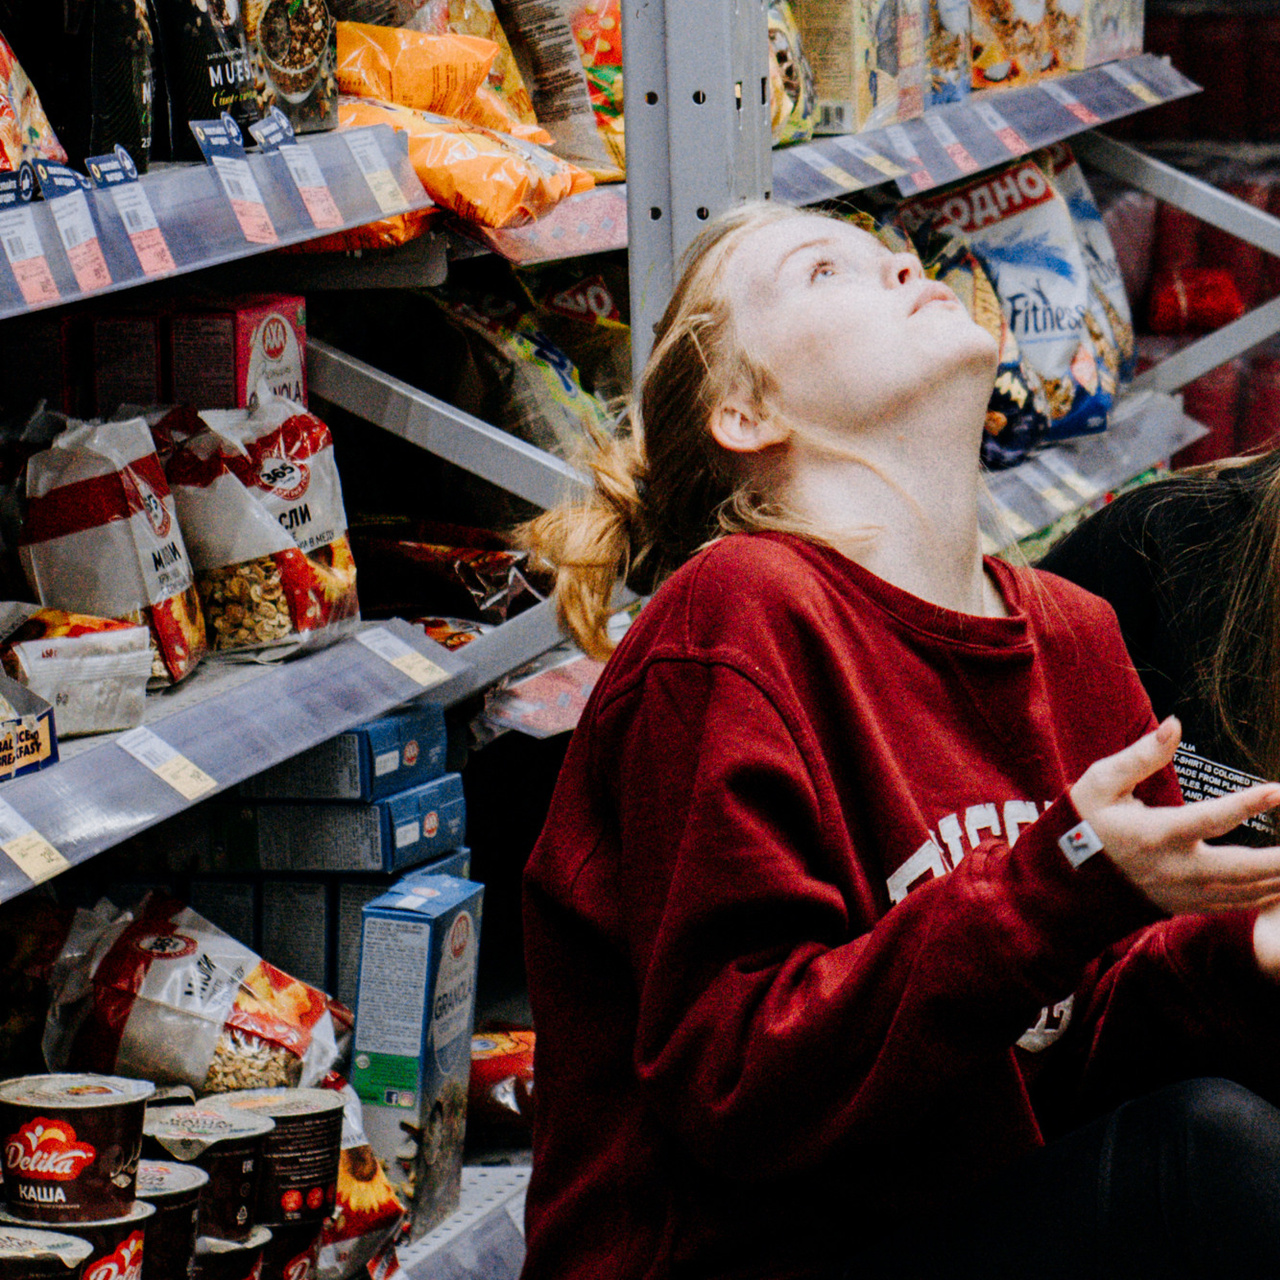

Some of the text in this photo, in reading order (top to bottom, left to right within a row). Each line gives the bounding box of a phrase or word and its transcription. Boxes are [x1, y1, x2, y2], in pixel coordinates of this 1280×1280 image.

[1006, 277, 1087, 334] Fitness
[261, 462, 296, 485] 365
[1173, 753, 1203, 769] T-SHIRT
[1213, 766, 1251, 786] COLORED
[1174, 764, 1198, 778] MADE
[1198, 771, 1222, 786] FROM
[5, 1141, 86, 1174] Delika
[18, 1183, 67, 1203] КАША
